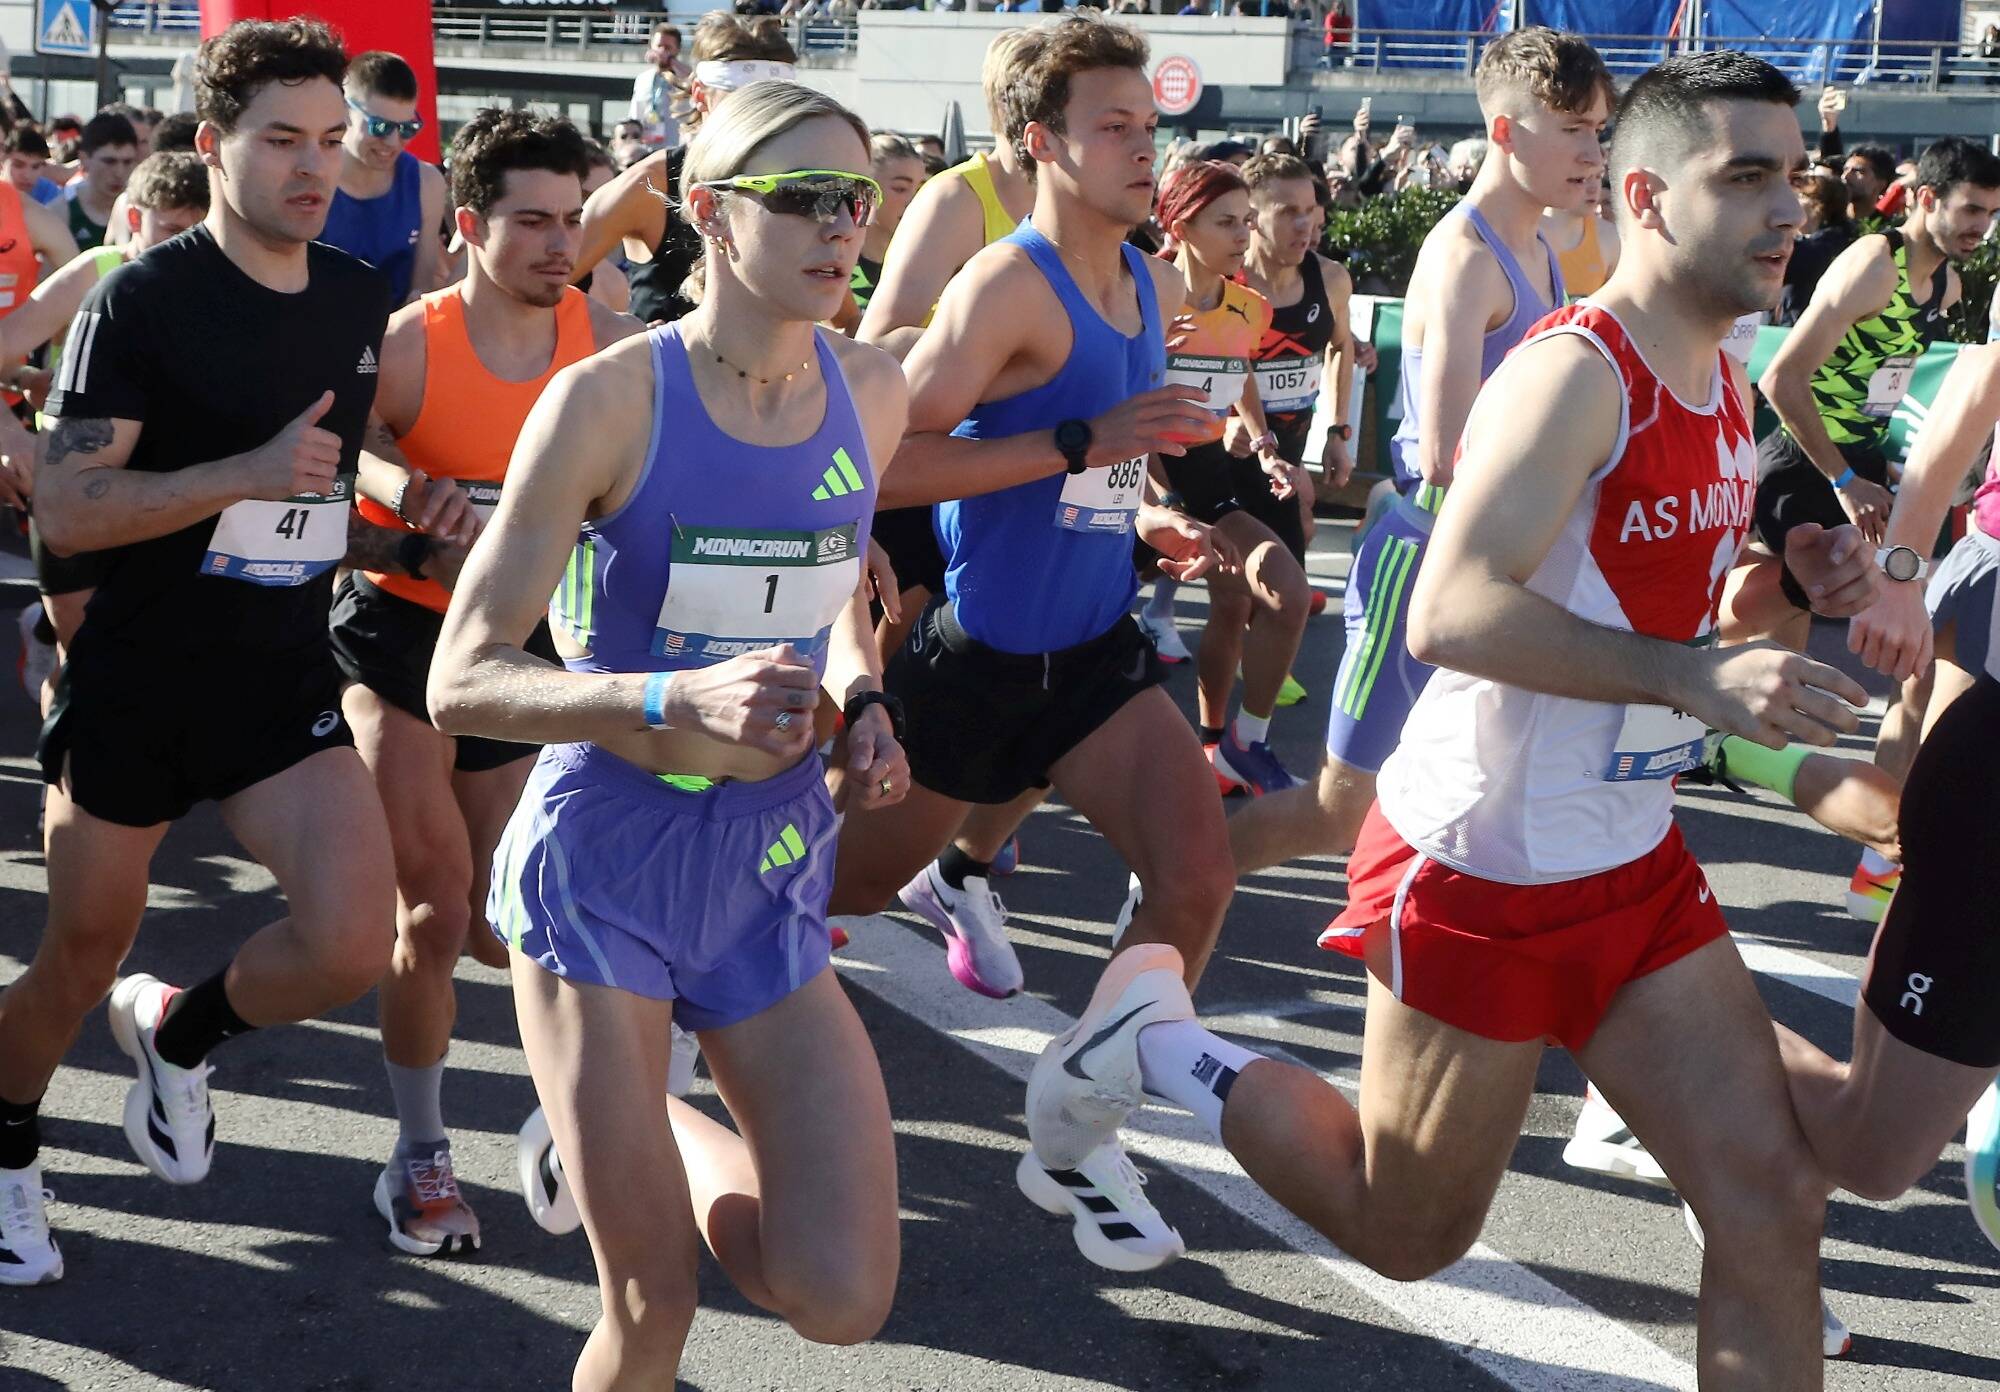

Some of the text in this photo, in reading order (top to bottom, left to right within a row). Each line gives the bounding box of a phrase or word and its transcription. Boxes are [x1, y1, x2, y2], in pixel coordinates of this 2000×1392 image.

[1202, 376, 1213, 394] 4
[1269, 371, 1307, 391] 1057
[1108, 458, 1142, 489] 886
[275, 508, 310, 540] 41
[1619, 495, 1679, 543] AS
[691, 537, 812, 558] MONACORUN
[763, 574, 779, 614] 1
